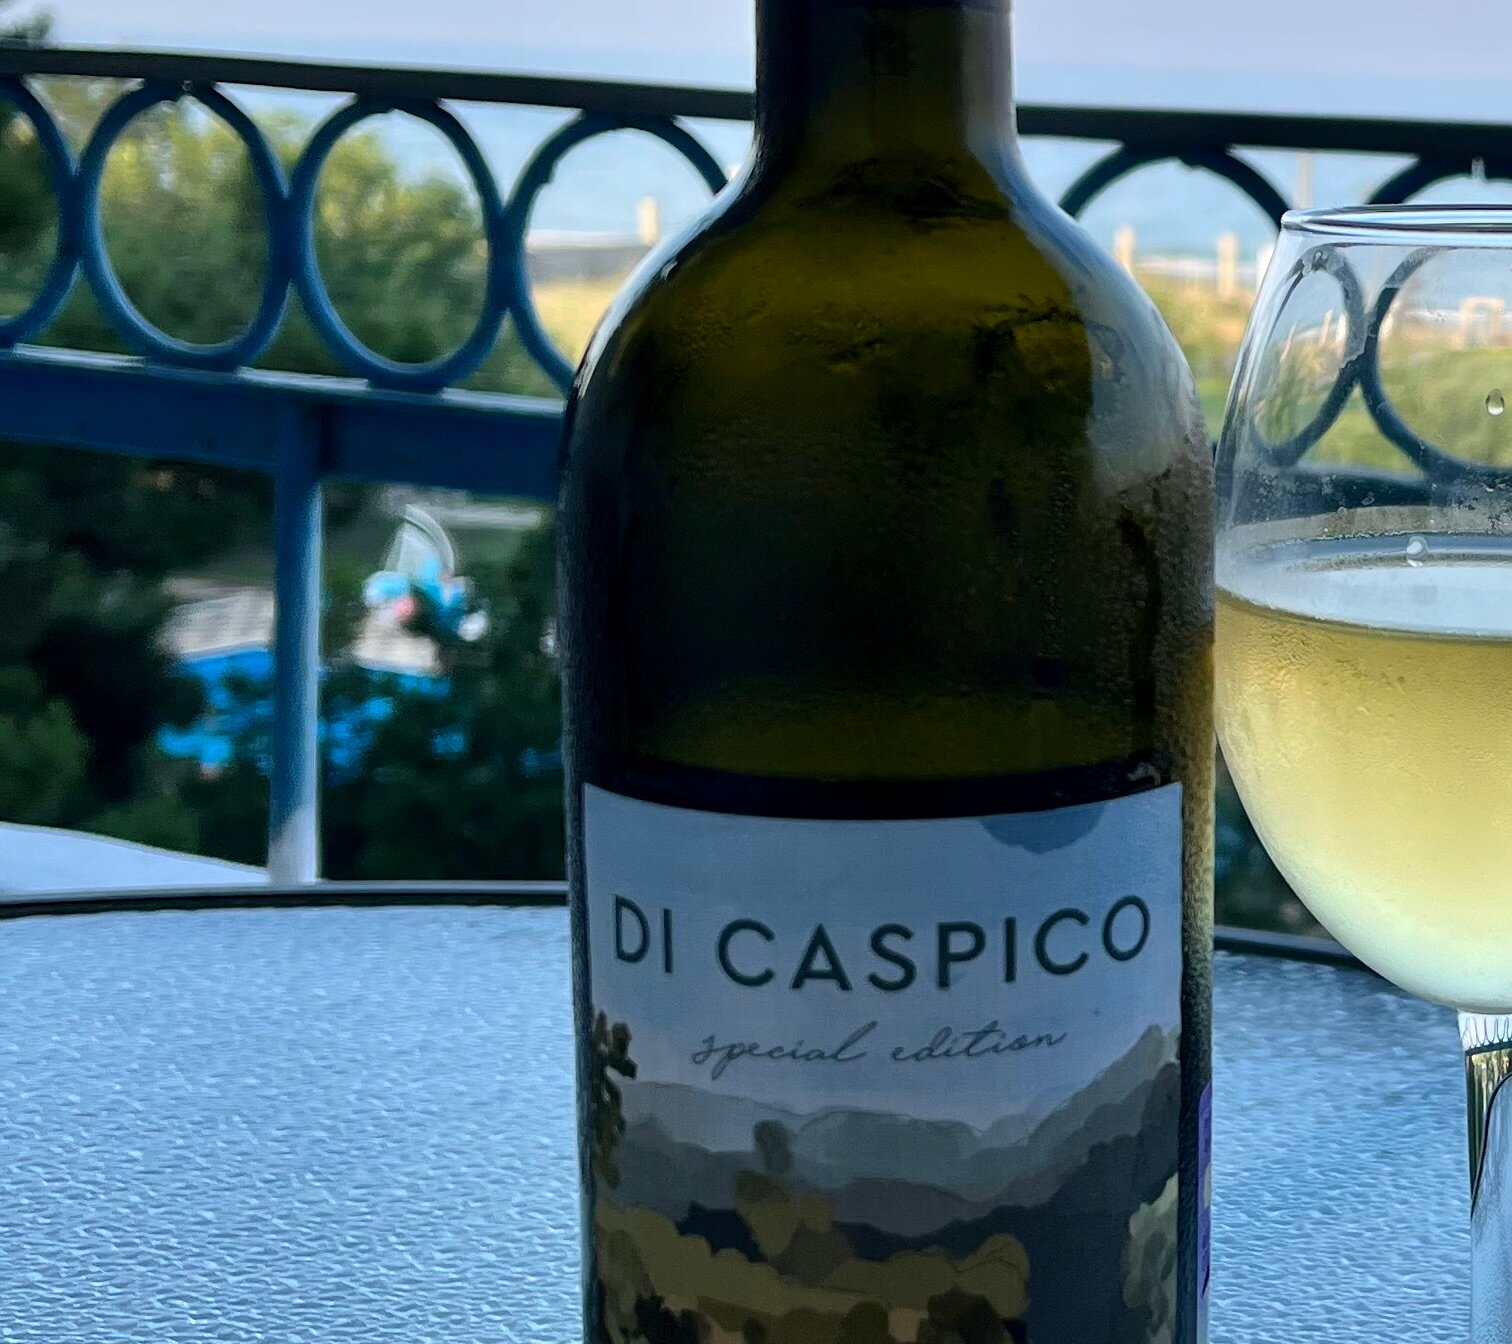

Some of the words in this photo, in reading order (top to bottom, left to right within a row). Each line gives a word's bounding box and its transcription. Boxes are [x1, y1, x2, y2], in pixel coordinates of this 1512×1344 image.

[614, 893, 674, 974] DI
[716, 894, 1151, 993] CASPICO
[691, 1021, 881, 1081] special
[893, 1020, 1069, 1066] edition
